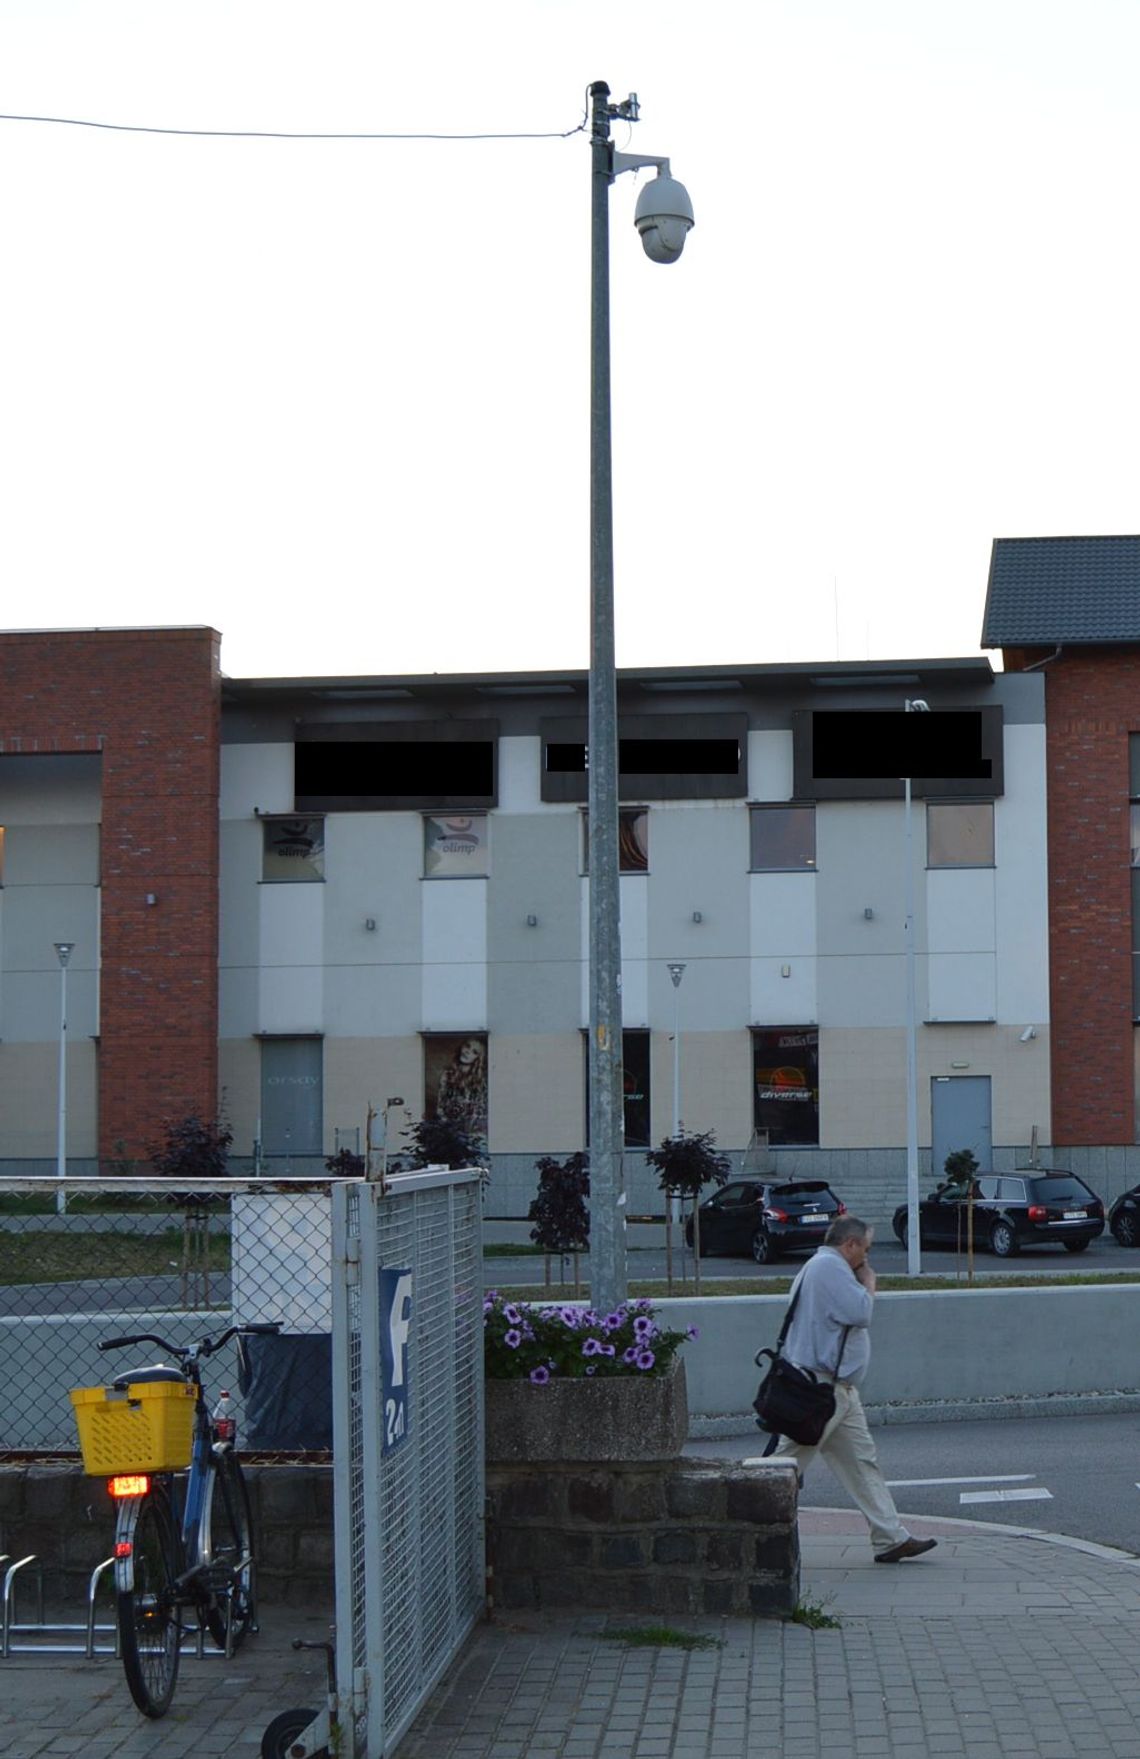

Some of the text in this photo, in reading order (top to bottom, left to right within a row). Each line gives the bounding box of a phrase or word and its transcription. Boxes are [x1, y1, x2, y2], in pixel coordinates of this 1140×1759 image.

[278, 846, 310, 860] olimp
[443, 842, 476, 856] olimp
[760, 1090, 813, 1099] diverse
